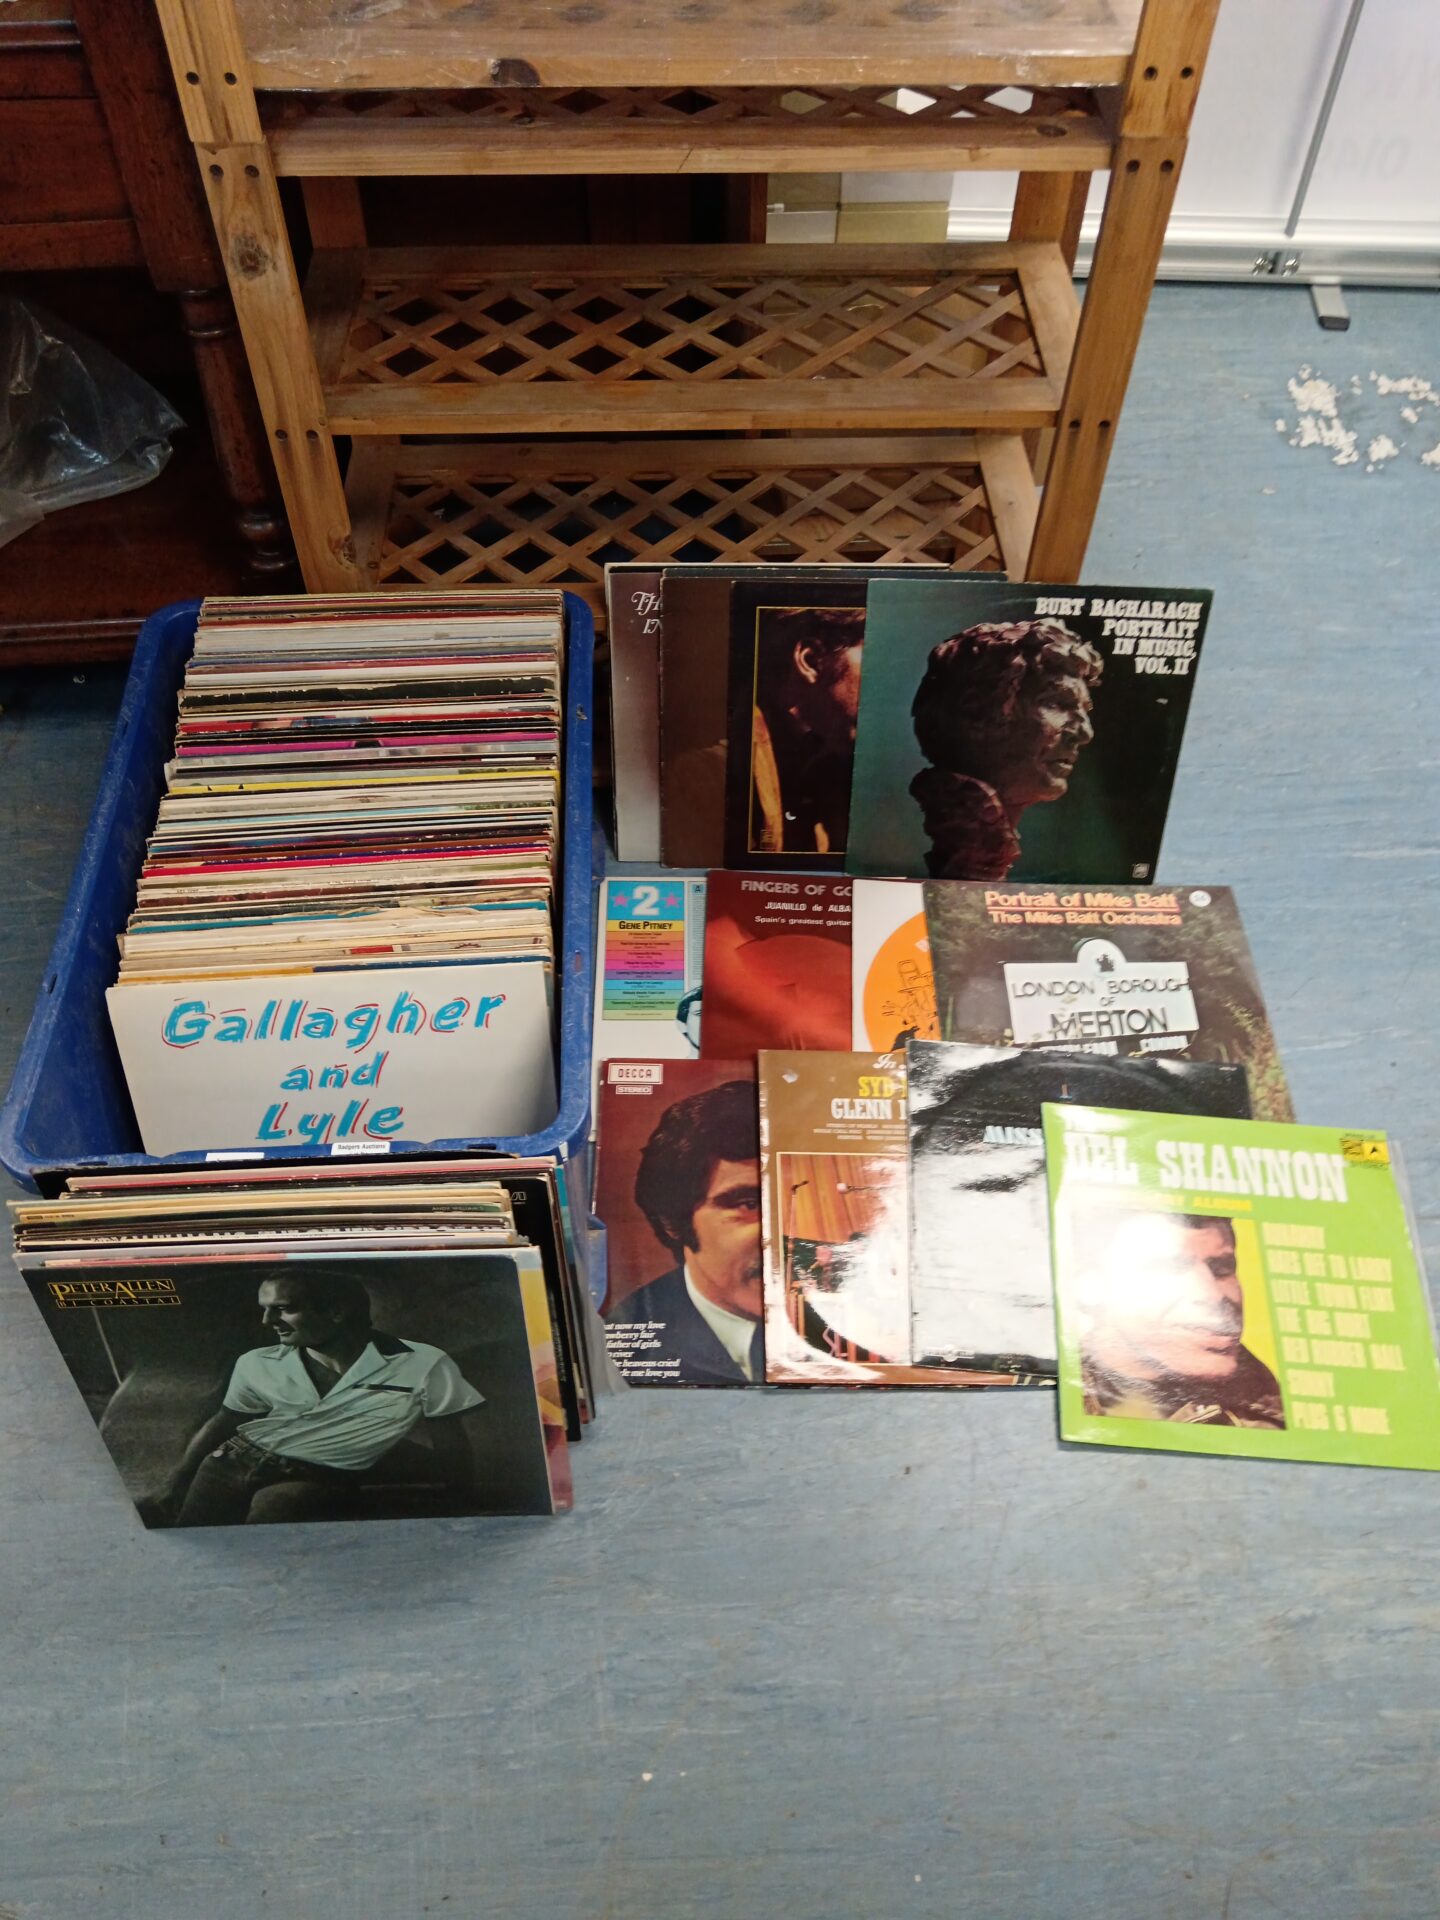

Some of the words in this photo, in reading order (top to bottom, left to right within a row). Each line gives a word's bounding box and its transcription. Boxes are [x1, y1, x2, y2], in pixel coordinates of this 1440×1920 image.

[1034, 596, 1086, 617] BURT
[1089, 597, 1203, 620] BACHARACH
[1102, 618, 1199, 639] PORTRAIT
[1112, 638, 1137, 656] IN
[1134, 656, 1172, 676] VOL.
[741, 880, 800, 894] FINGERS
[804, 884, 827, 896] OF
[631, 885, 661, 916] 2
[765, 902, 807, 911] JUANILLO
[812, 904, 823, 912] de
[985, 890, 1057, 908] Portrait
[1060, 890, 1083, 907] of
[1084, 891, 1132, 909] Mike
[1134, 893, 1179, 910] Batt
[618, 920, 641, 931] GENE
[643, 920, 673, 931] PITNEY
[754, 915, 786, 924] Spain's
[789, 918, 823, 926] greatest
[989, 910, 1024, 925] The
[1025, 911, 1064, 925] Mike
[1066, 911, 1101, 926] Batt
[1102, 912, 1183, 926] Orchestra
[1011, 979, 1095, 999] LONDON
[1107, 976, 1191, 995] BOROUGH
[1099, 995, 1116, 1008] OF
[160, 990, 507, 1054] Gallagher
[1050, 1007, 1169, 1040] MERTON
[279, 1051, 390, 1091] and
[617, 1068, 652, 1079] DECCA
[858, 1075, 894, 1098] SYD
[831, 1098, 893, 1120] GLENN
[254, 1098, 405, 1145] Lyle
[1156, 1139, 1348, 1203] SHANNON
[52, 1281, 113, 1301] PETER
[114, 1280, 172, 1299] ALLEN
[90, 1297, 176, 1307] COASTAL
[633, 1323, 648, 1331] my
[647, 1321, 667, 1330] love
[640, 1330, 657, 1339] fair
[631, 1339, 643, 1348] of
[640, 1339, 662, 1350] girls
[622, 1359, 657, 1367] heavens
[657, 1358, 682, 1367] cried
[645, 1368, 663, 1377] love
[662, 1370, 681, 1379] you
